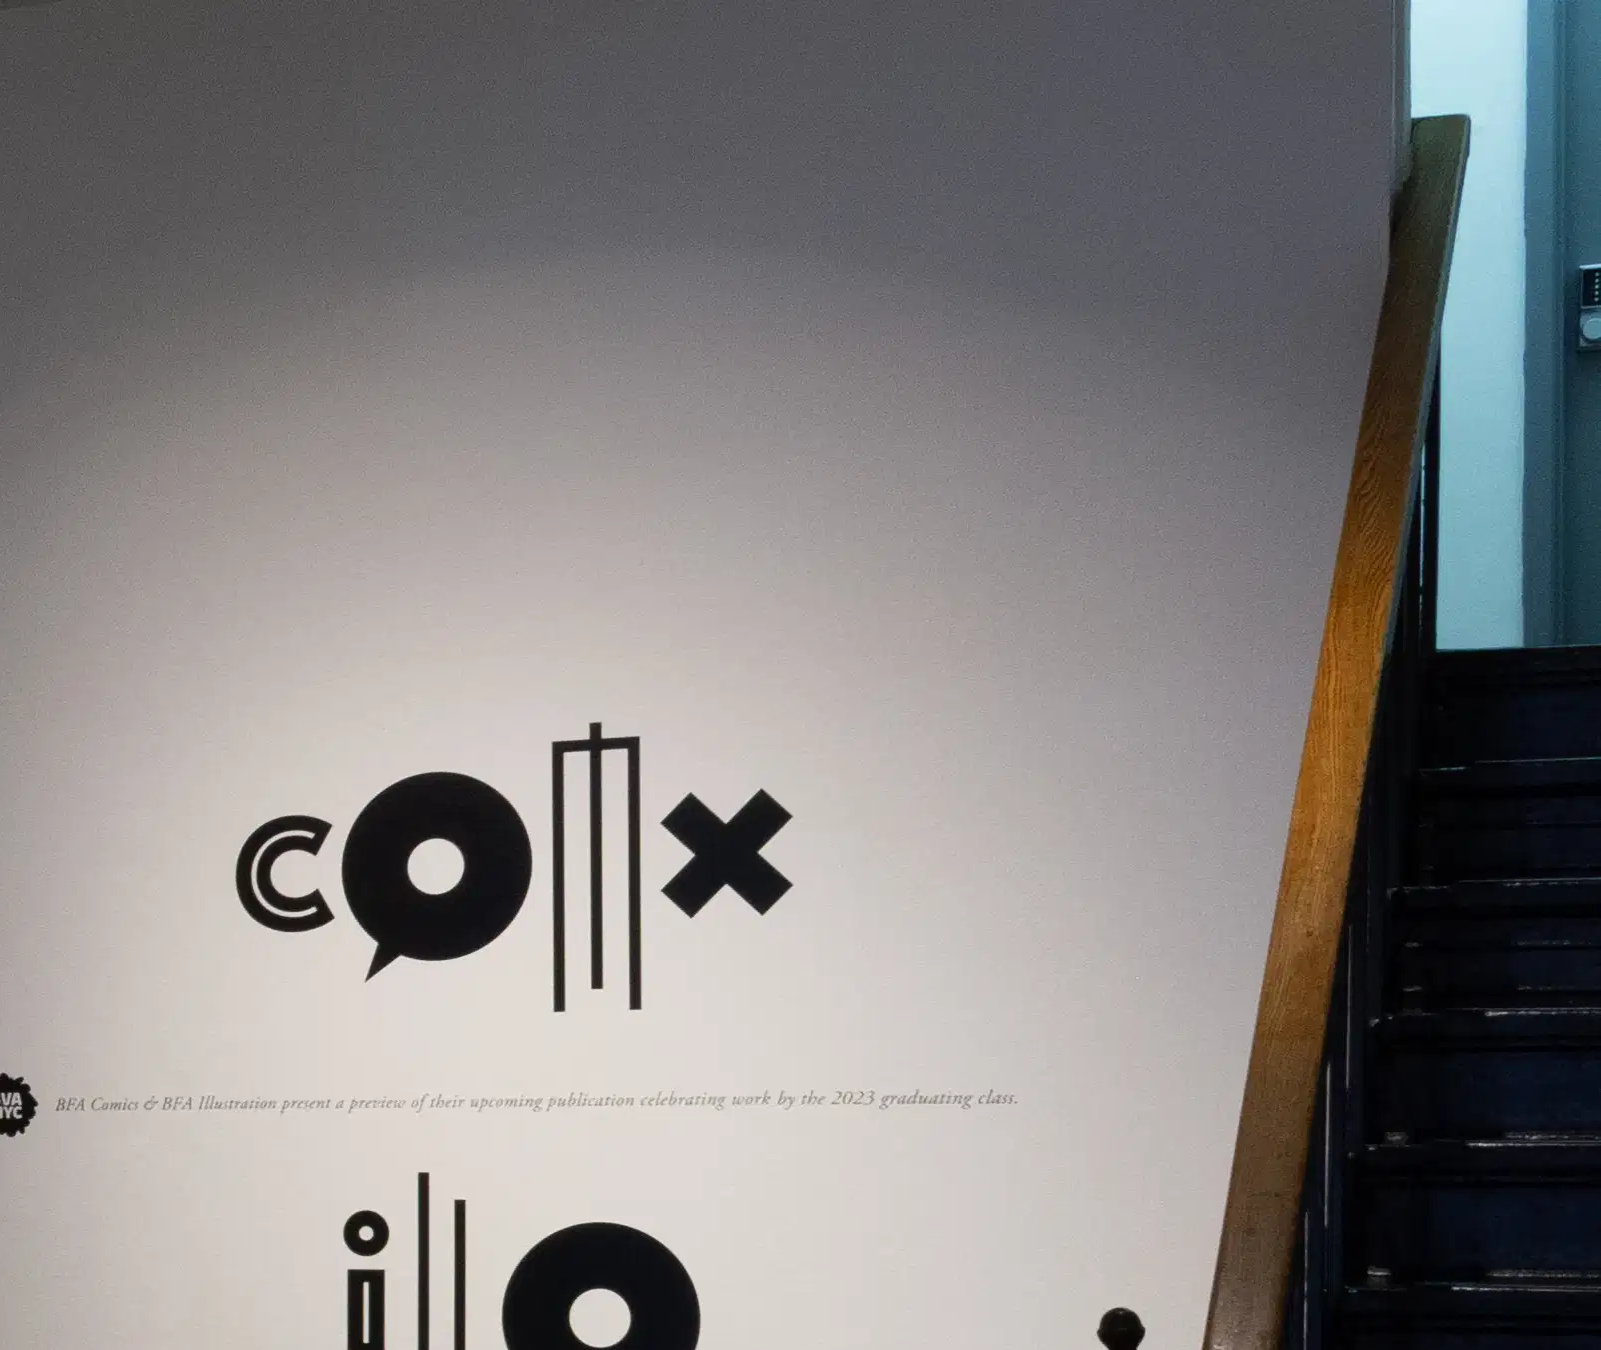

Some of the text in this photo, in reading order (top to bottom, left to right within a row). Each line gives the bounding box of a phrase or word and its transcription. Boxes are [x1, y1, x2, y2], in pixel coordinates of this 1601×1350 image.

[55, 1089, 1019, 1114] BFA Comics & BFA Illustration present a preview of their upcoming publication celebrating work by the 2023 graduating class.
